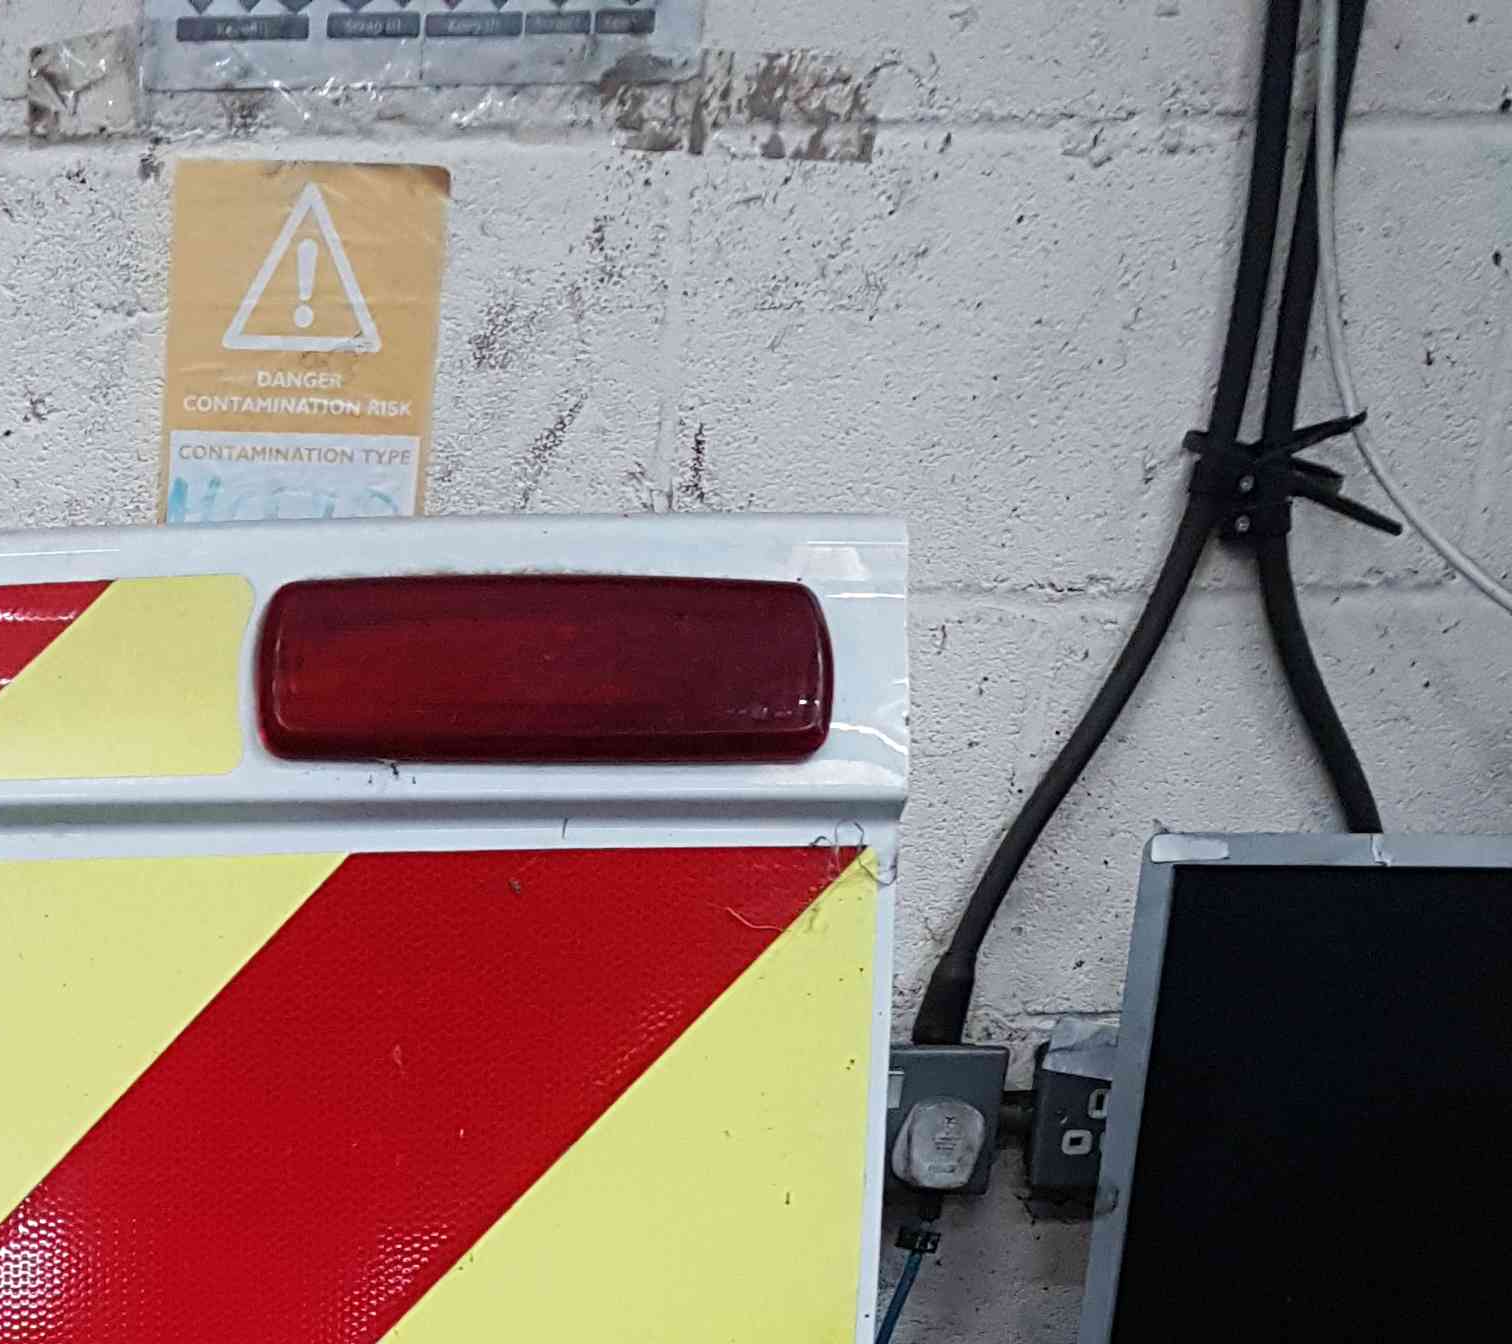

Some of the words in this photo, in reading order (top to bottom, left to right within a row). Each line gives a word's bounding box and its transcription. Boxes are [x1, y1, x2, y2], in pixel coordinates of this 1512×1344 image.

[256, 370, 344, 389] DANGER
[182, 394, 362, 417] CONTAMINATION
[366, 398, 413, 418] RISK
[178, 443, 355, 464] CONTAMINATION
[362, 447, 411, 466] TYPE
